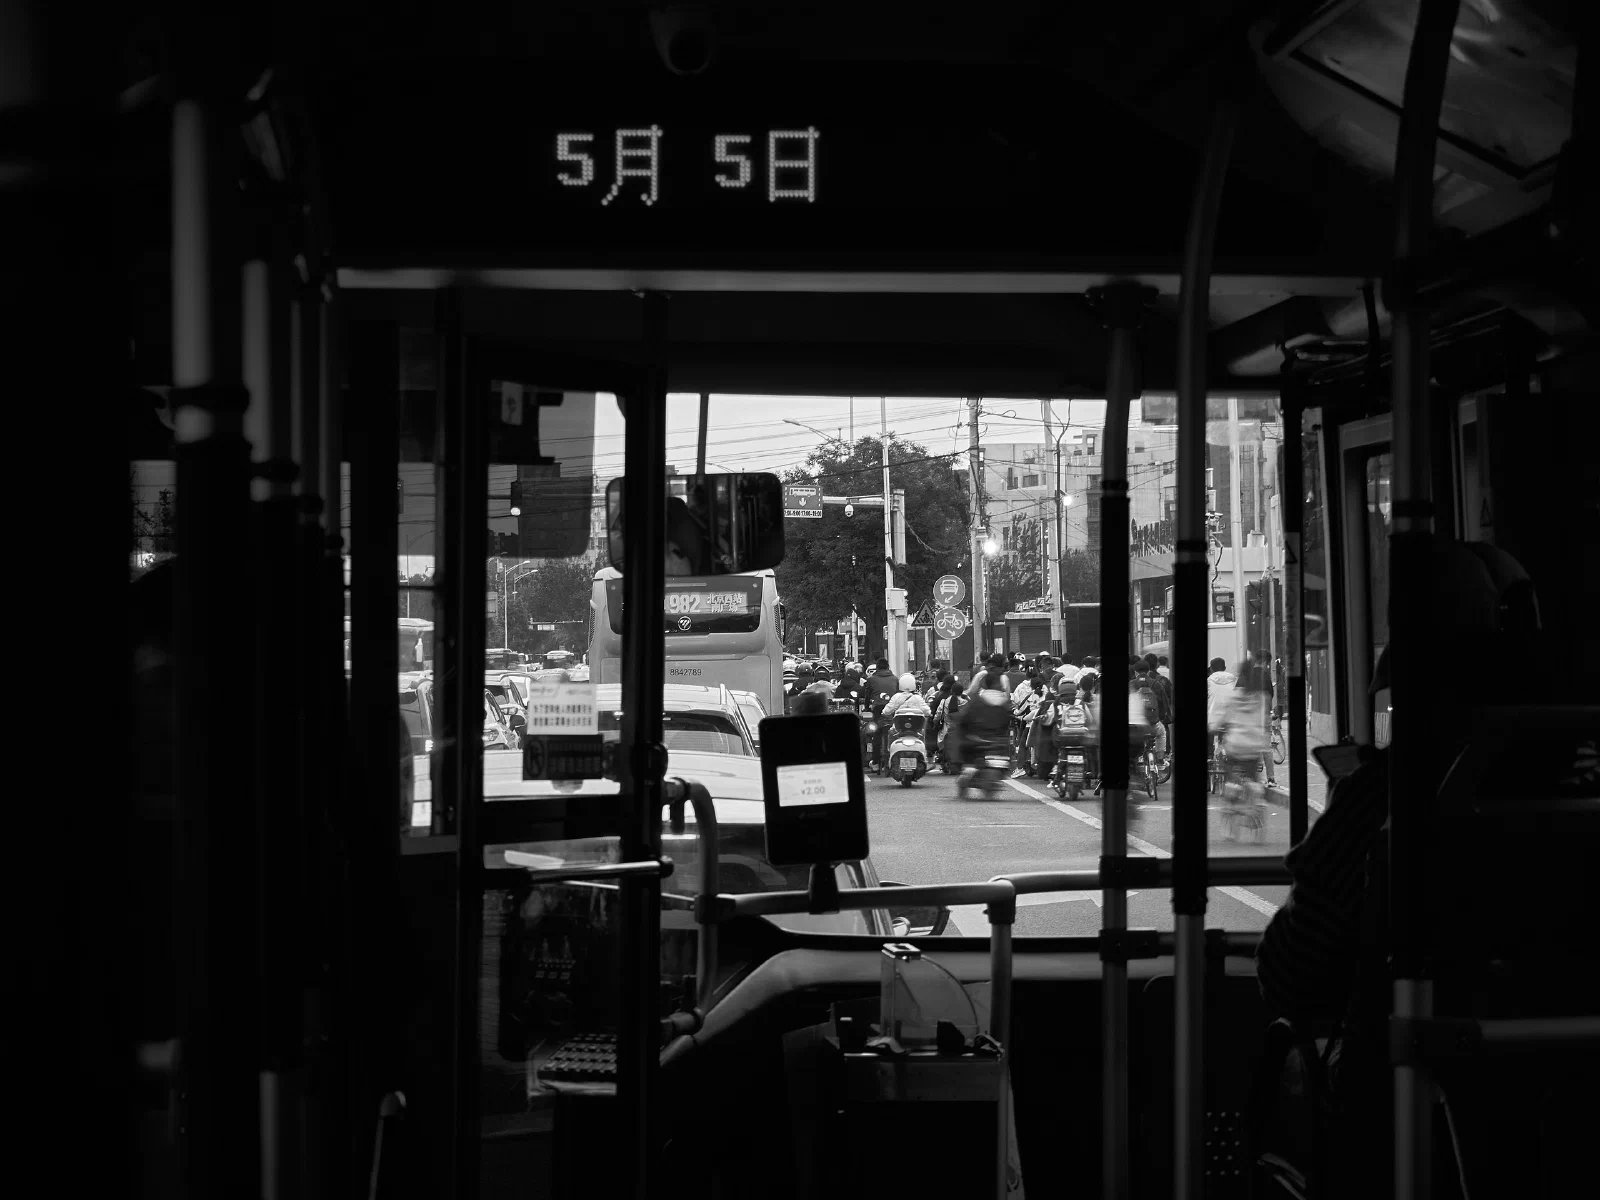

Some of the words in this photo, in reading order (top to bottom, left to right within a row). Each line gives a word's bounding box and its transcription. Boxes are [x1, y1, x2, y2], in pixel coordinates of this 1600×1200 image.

[556, 124, 663, 206] 5月
[714, 126, 820, 203] 5日
[669, 594, 701, 614] 982
[706, 592, 743, 604] 北京西站
[669, 668, 702, 677] 8842789
